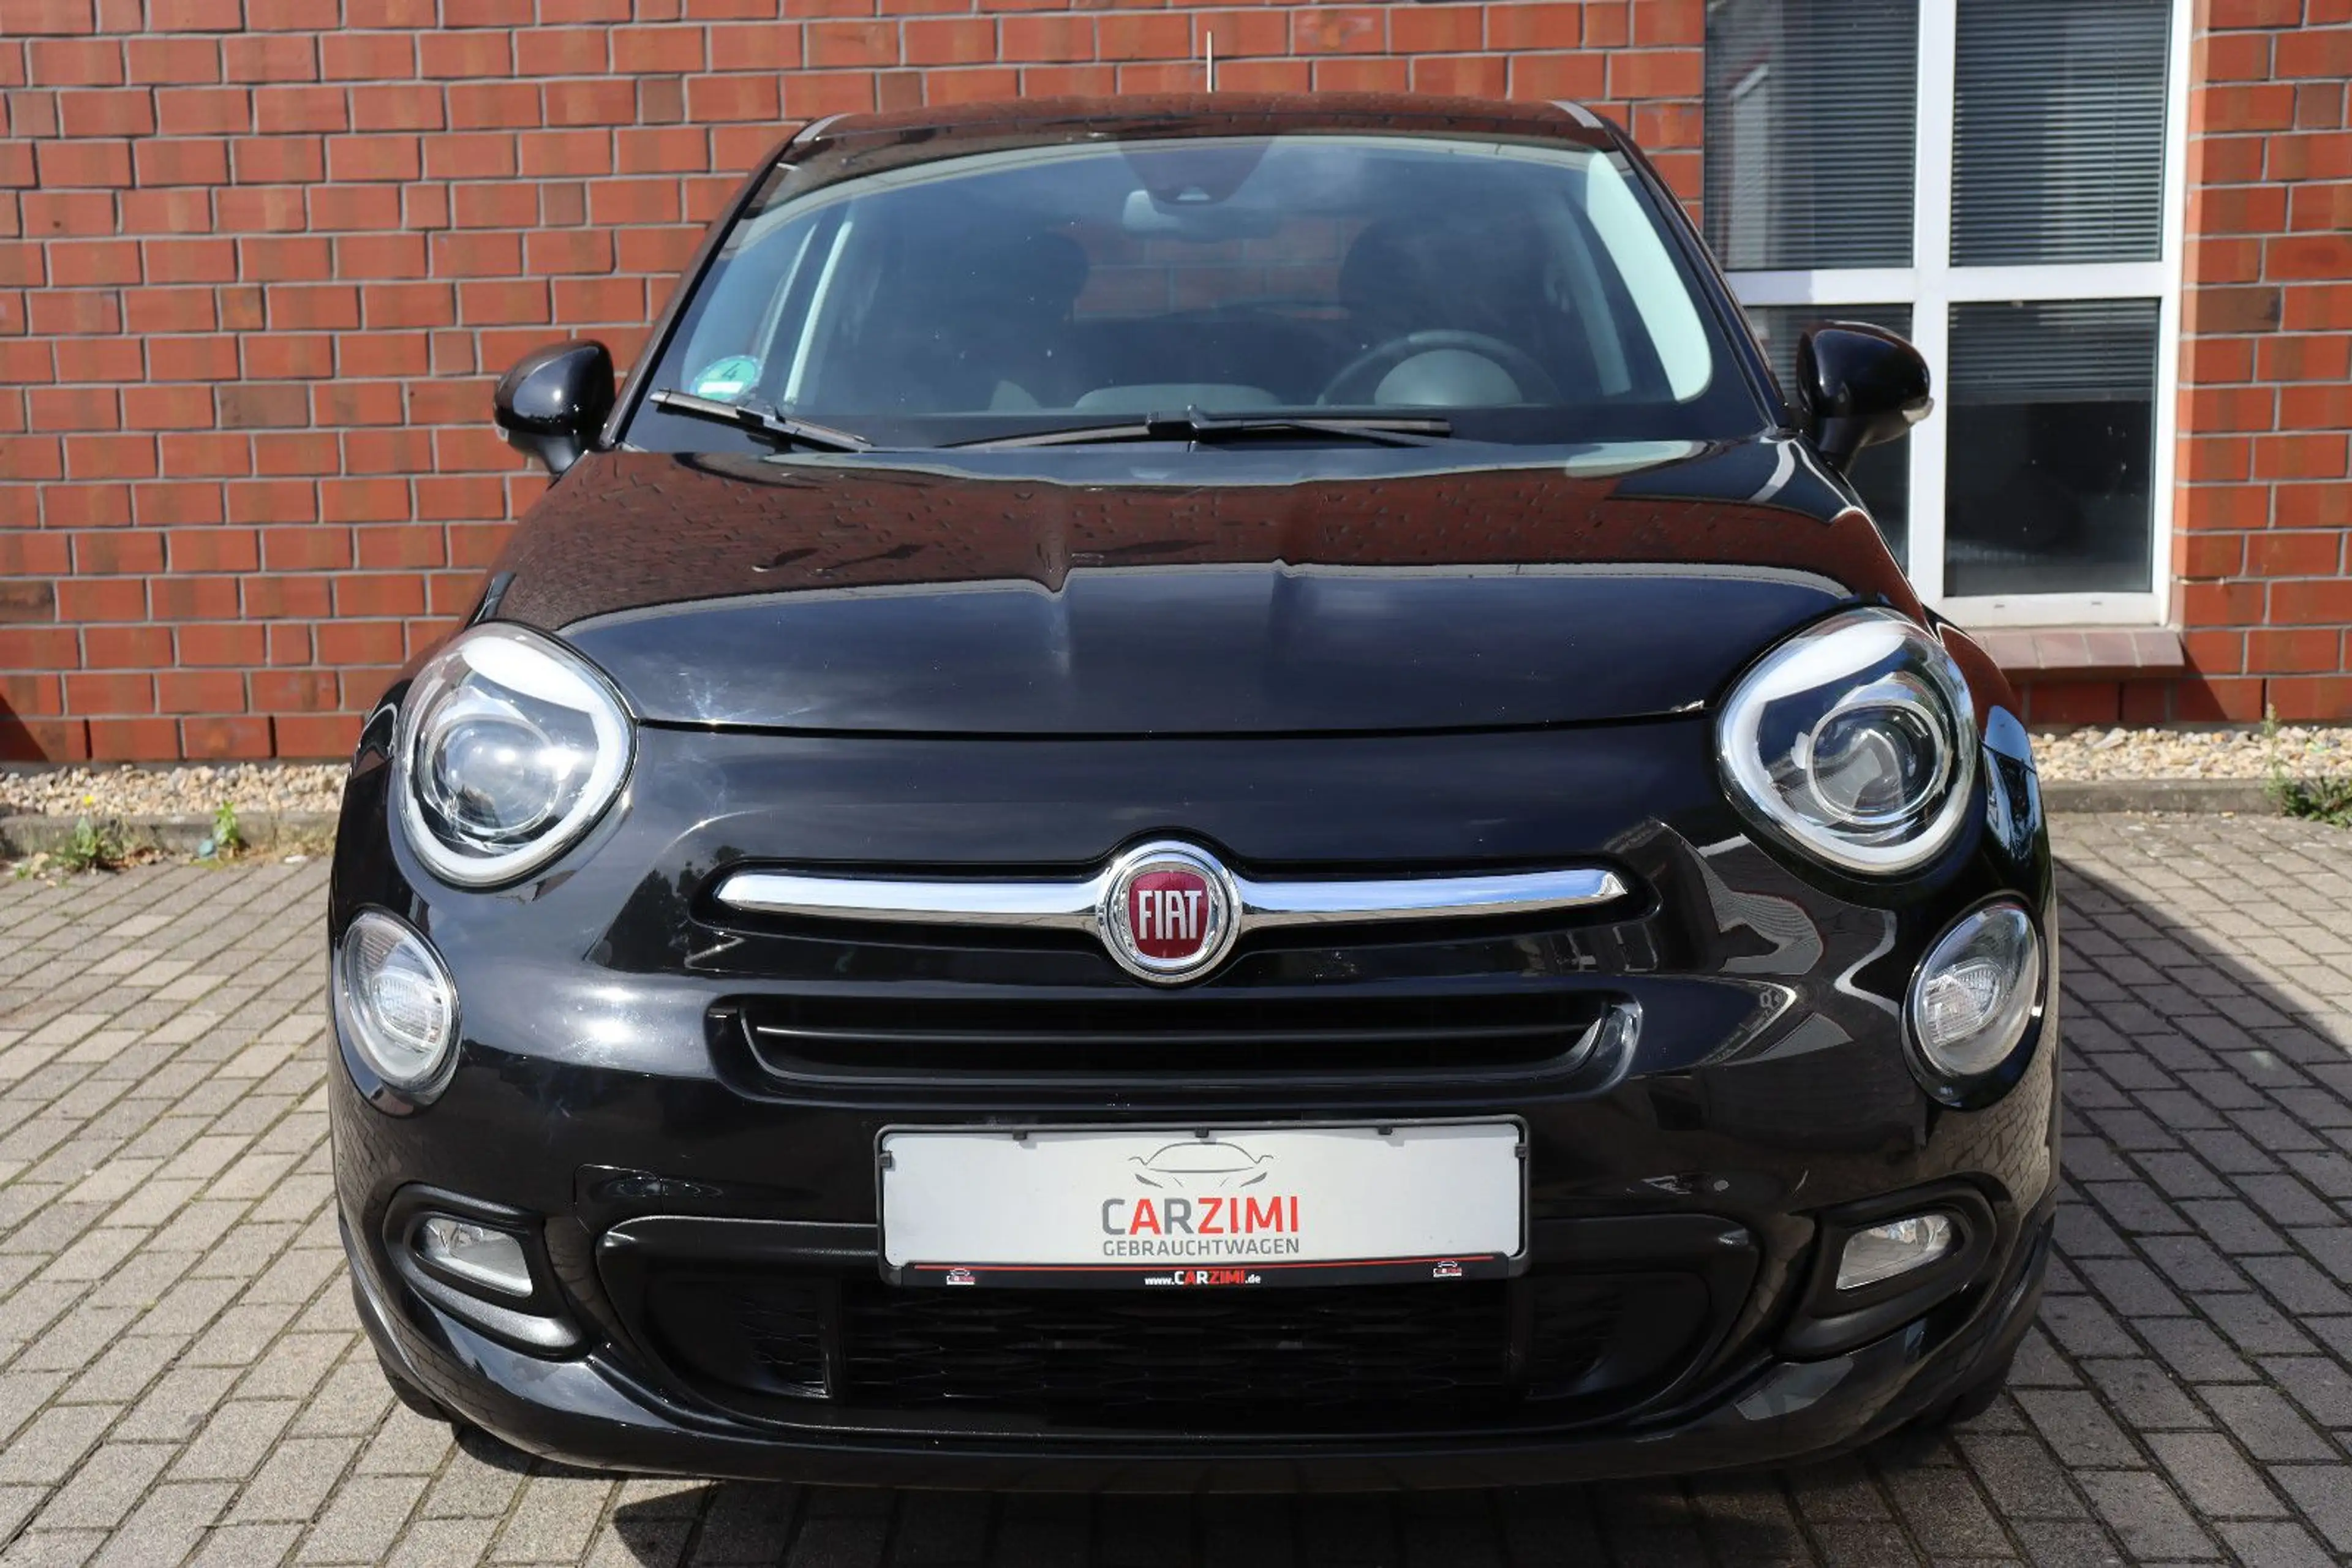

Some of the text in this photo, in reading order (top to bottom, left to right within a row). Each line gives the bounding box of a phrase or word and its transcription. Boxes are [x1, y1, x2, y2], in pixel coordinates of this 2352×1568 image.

[722, 363, 740, 380] 4
[1138, 891, 1202, 940] FIAT
[1102, 1196, 1298, 1235] CARZIMI
[1104, 1238, 1298, 1256] GEBRAUCHTWAGEN
[1144, 1270, 1261, 1286] www.CARZIMI.de
